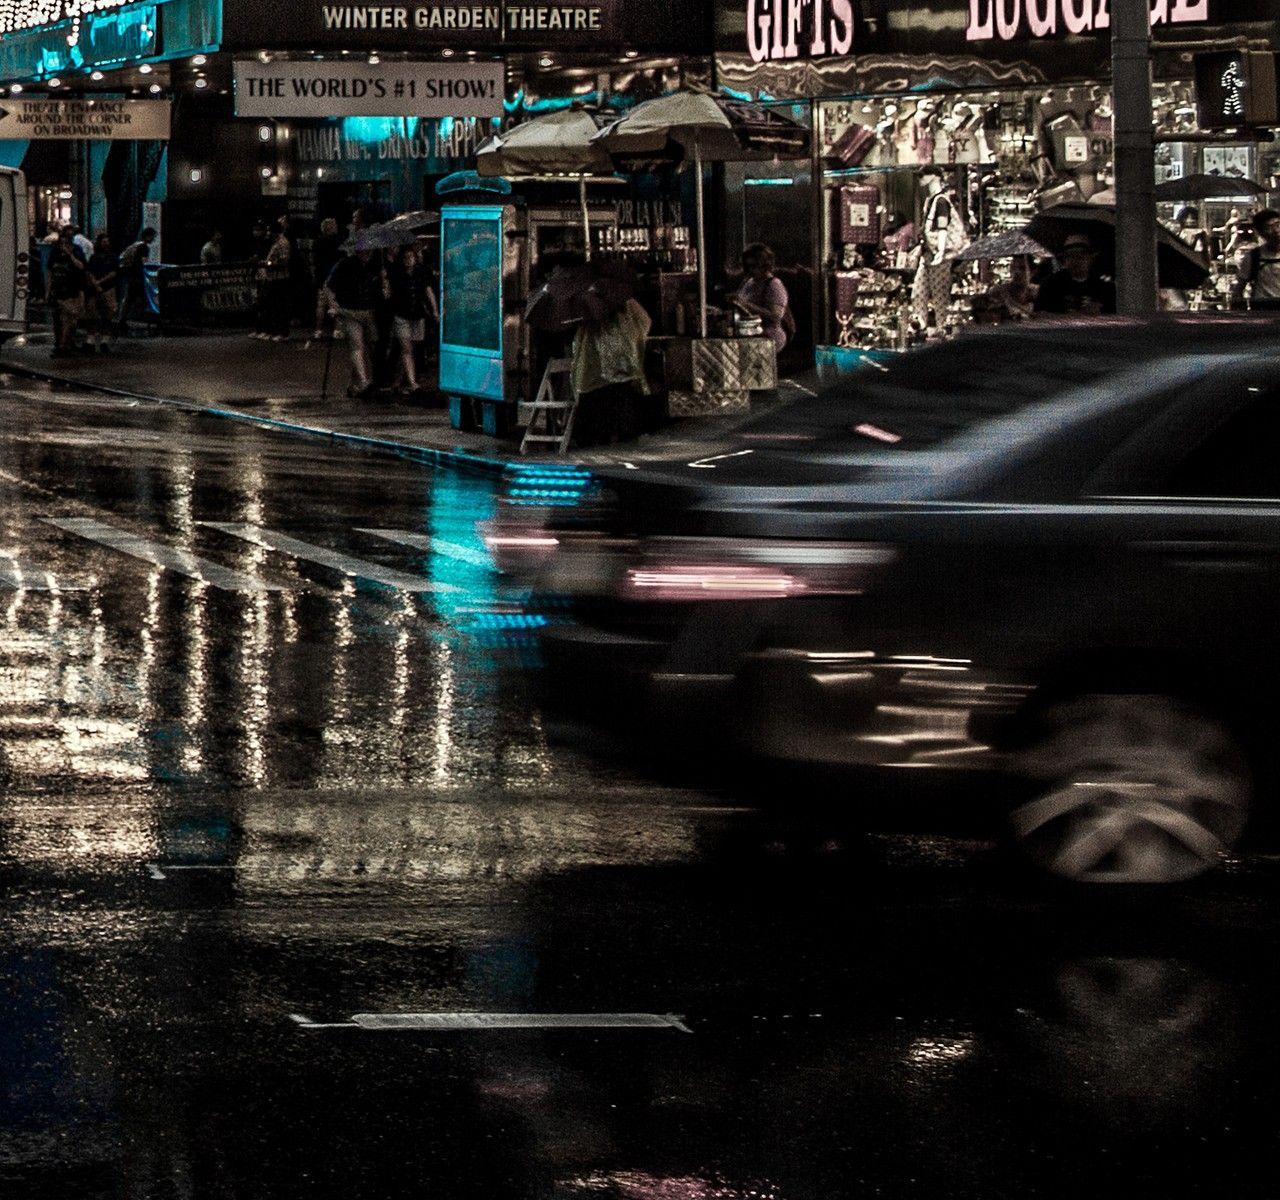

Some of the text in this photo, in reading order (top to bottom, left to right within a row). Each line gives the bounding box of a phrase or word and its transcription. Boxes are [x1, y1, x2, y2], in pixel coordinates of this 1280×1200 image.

[322, 6, 601, 30] WINTER GARDEN THEATRE
[245, 78, 495, 99] THE WORLD'S #1 SHOW!
[17, 114, 132, 124] AROUND THE CORNER
[33, 125, 113, 135] ON BROADWAY
